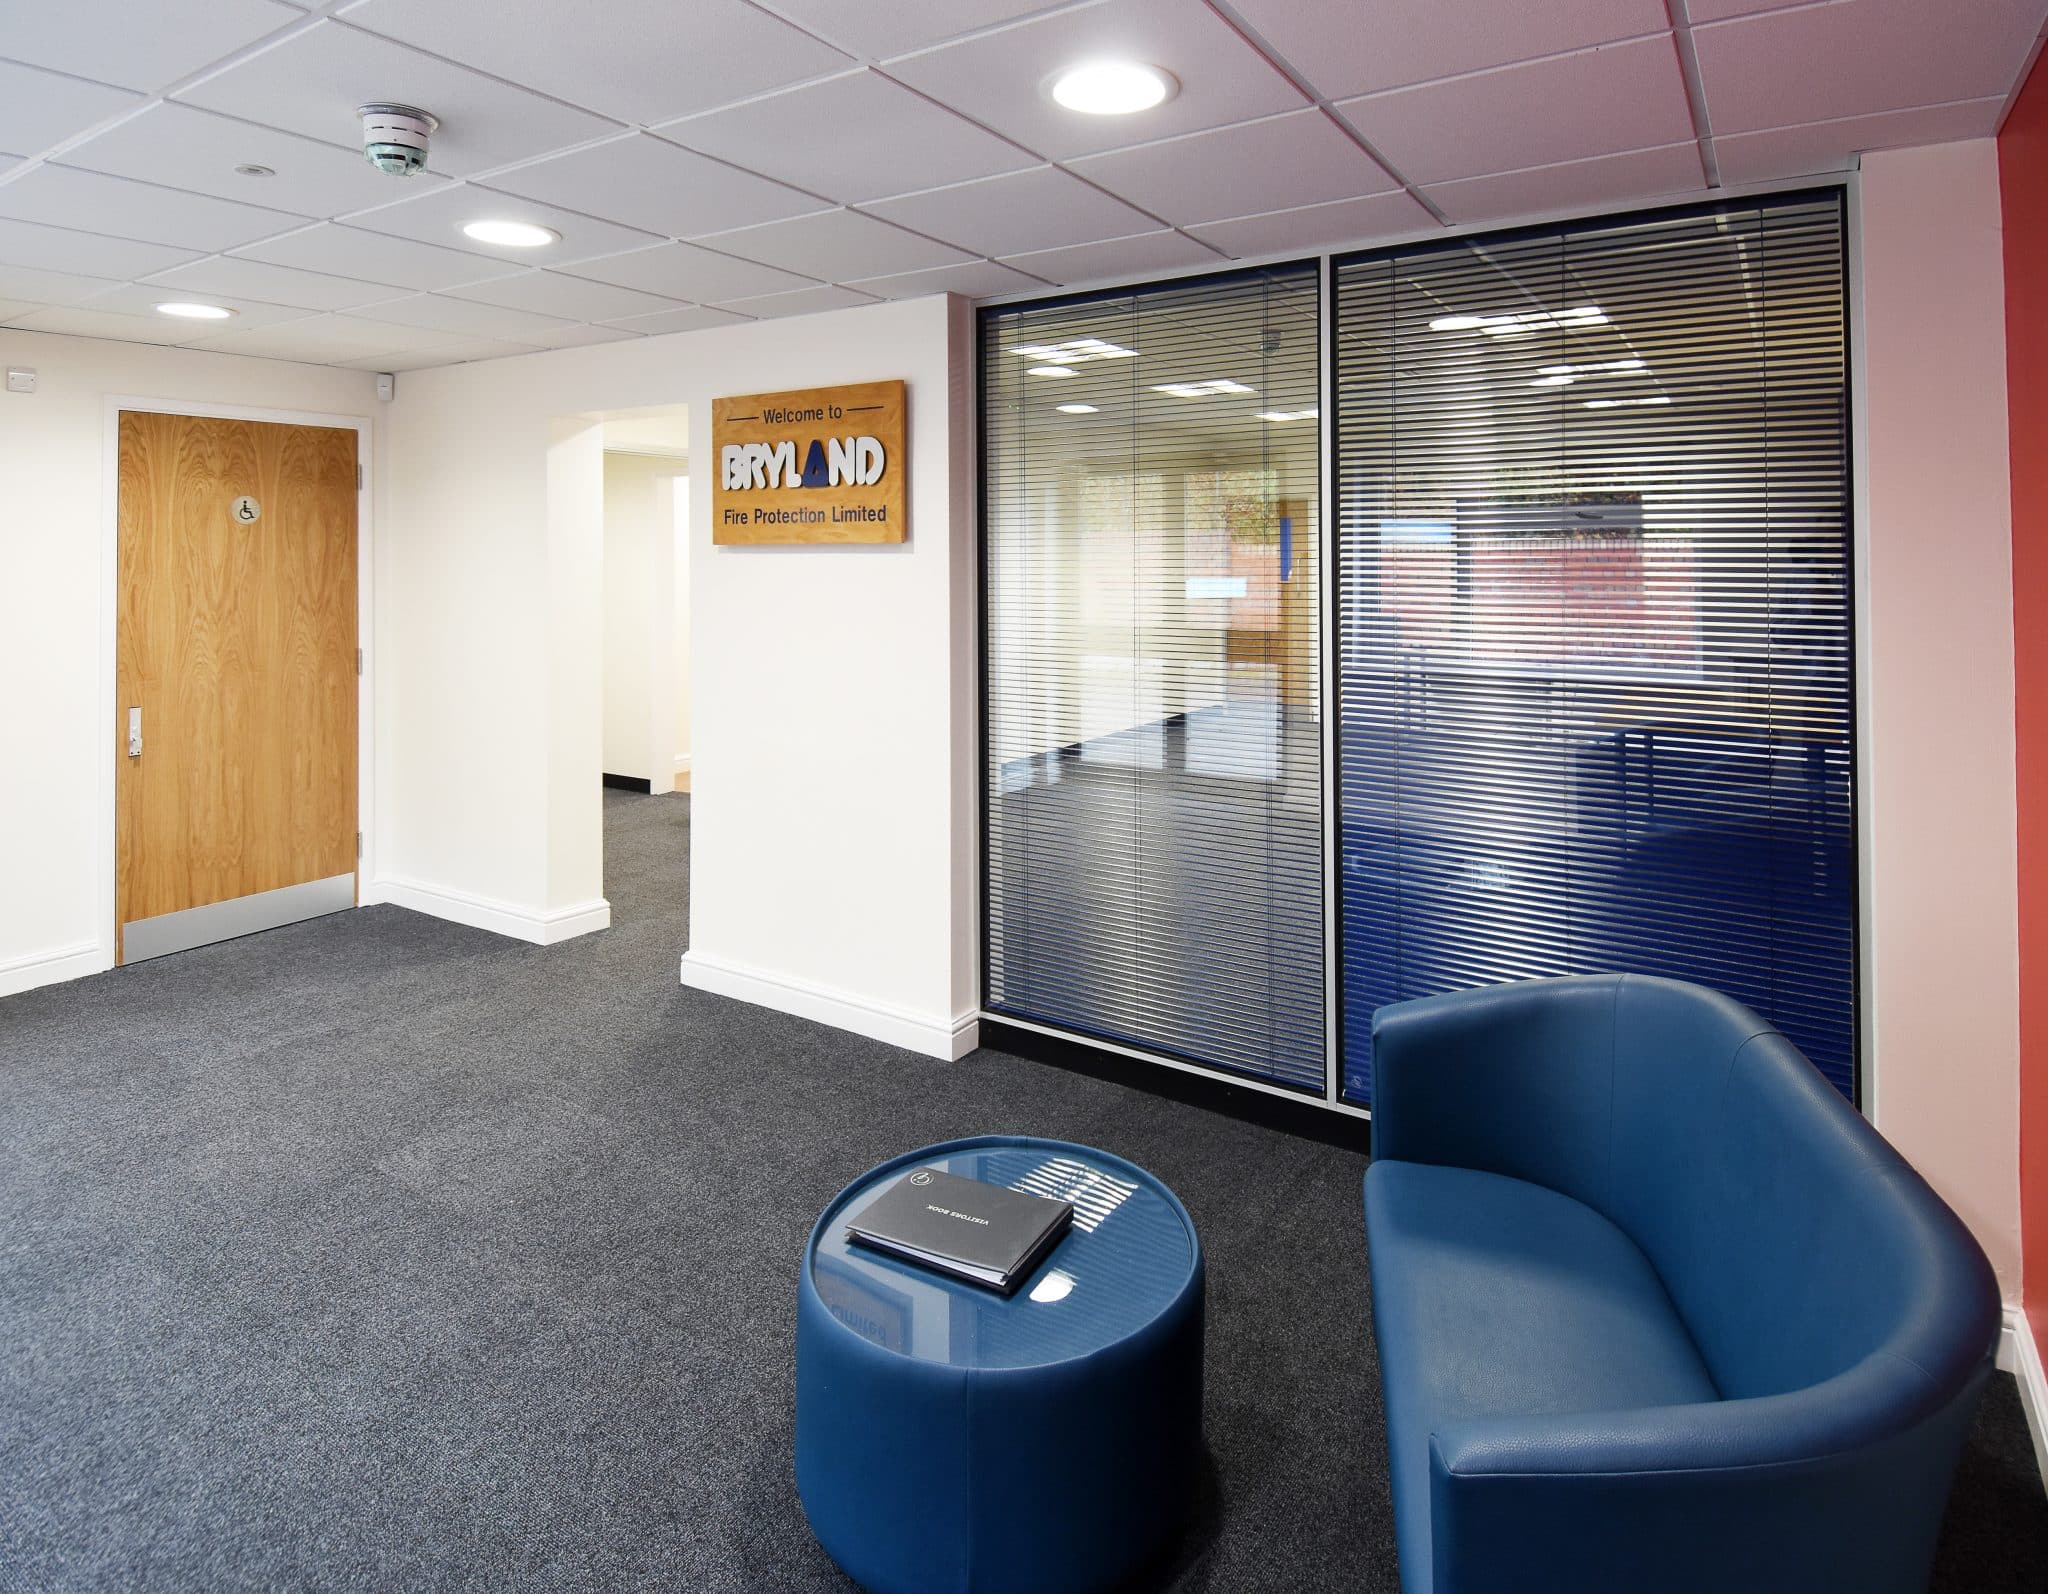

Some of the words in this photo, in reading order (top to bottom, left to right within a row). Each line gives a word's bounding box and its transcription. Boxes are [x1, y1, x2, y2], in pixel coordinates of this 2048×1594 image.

[763, 408, 824, 424] Welcome
[828, 405, 842, 419] to
[721, 436, 885, 490] BRYLAND
[724, 508, 748, 524] Fire
[754, 507, 825, 524] Protection
[832, 505, 887, 523] Limited
[926, 1204, 950, 1215] BOOK
[949, 1211, 989, 1225] VISITORS
